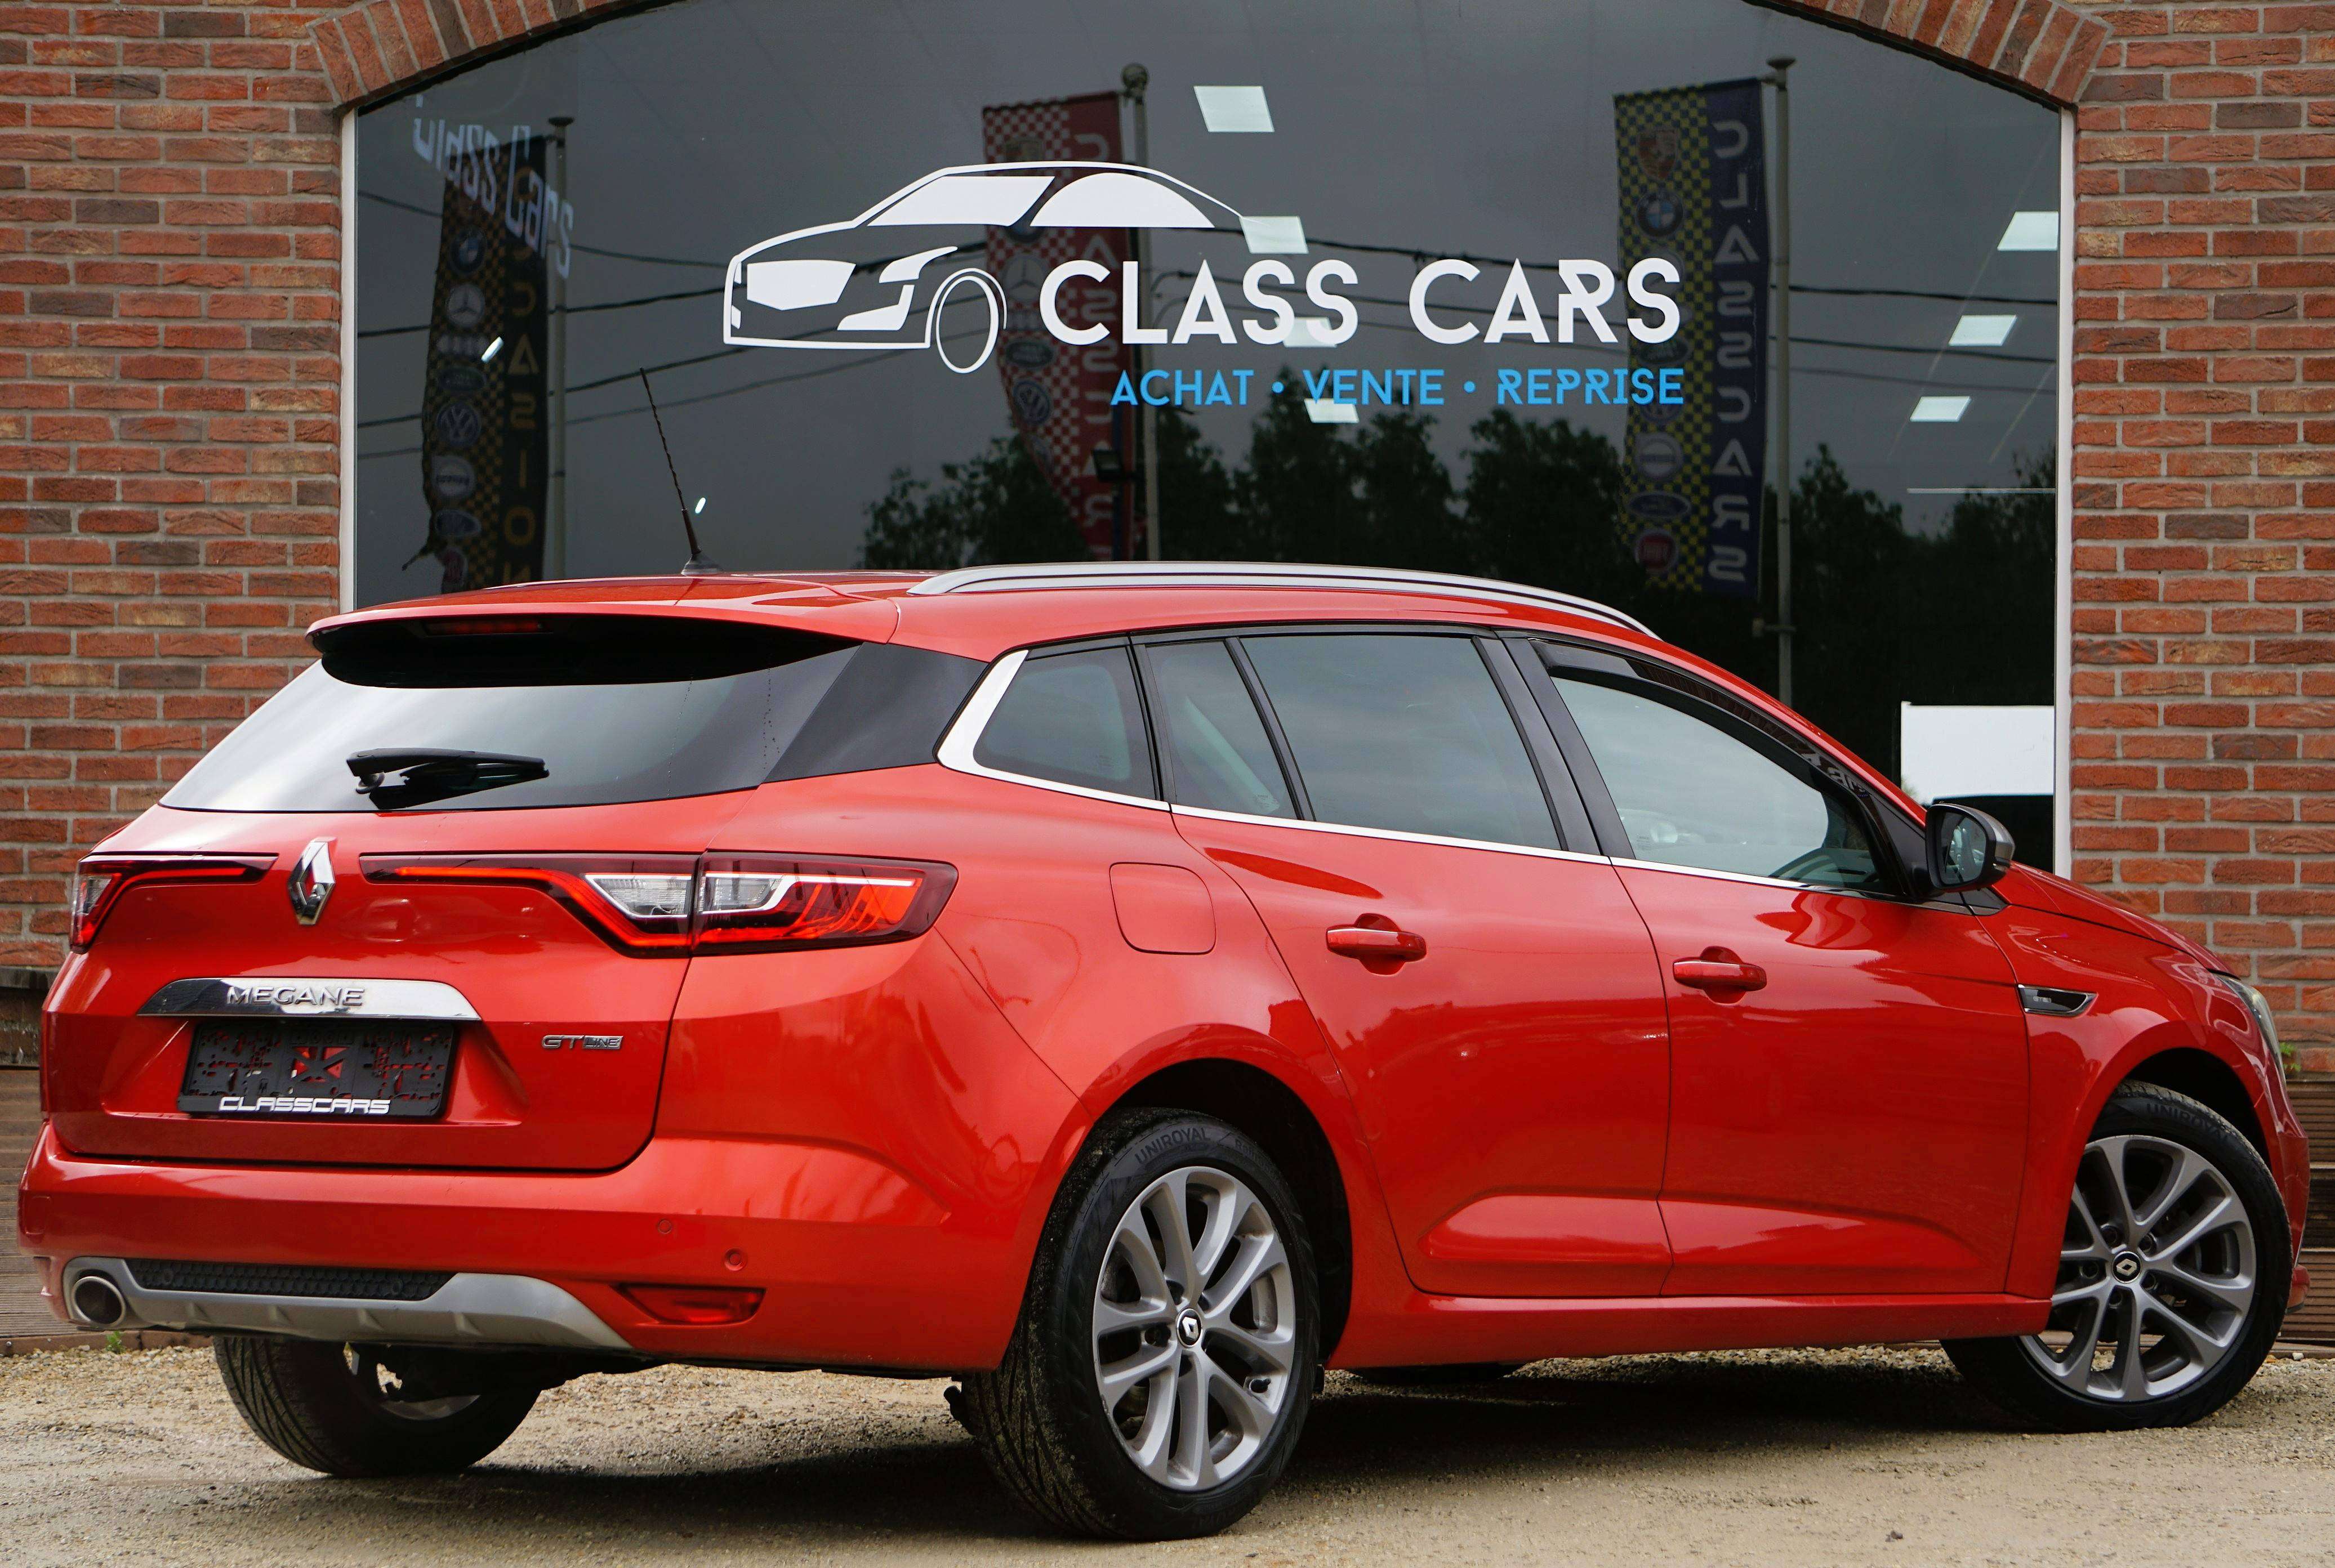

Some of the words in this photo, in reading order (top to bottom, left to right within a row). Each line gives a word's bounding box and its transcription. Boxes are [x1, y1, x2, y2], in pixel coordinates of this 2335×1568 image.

[1040, 260, 1358, 345] CLASS
[1409, 257, 1680, 344] CARS
[1110, 369, 1255, 406] ACHAT
[1303, 369, 1445, 406] VENTE
[1497, 368, 1685, 405] REPRISE
[226, 986, 367, 1008] MEGANE
[542, 1034, 584, 1049] GT
[219, 1096, 391, 1115] CLASSCARS
[1135, 1127, 1211, 1164] UNIROYAL
